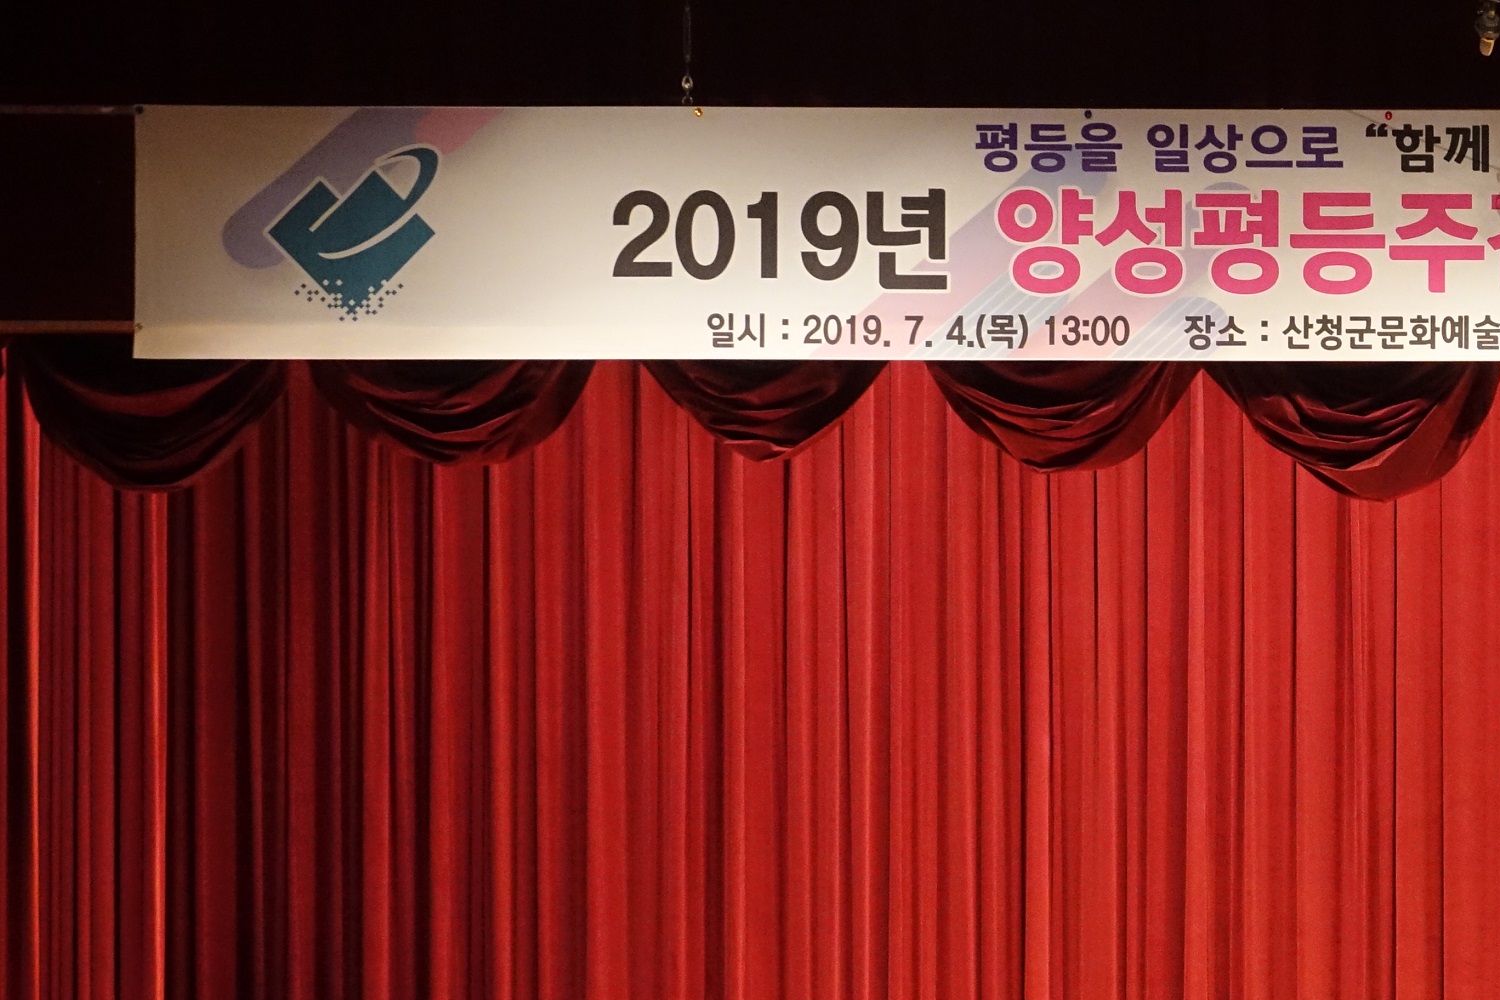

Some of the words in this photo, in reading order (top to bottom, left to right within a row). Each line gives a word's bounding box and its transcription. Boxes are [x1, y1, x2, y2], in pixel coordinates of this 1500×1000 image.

[976, 123, 1122, 173] 평등을
[1147, 124, 1343, 173] 일상으로
[613, 189, 947, 289] 2019년
[708, 313, 765, 347] 일시
[804, 315, 890, 347] 2019.
[905, 315, 932, 347] 7.
[947, 314, 1029, 350] 4.(목)
[1045, 315, 1130, 346] 13:00
[1184, 315, 1246, 350] 장소
